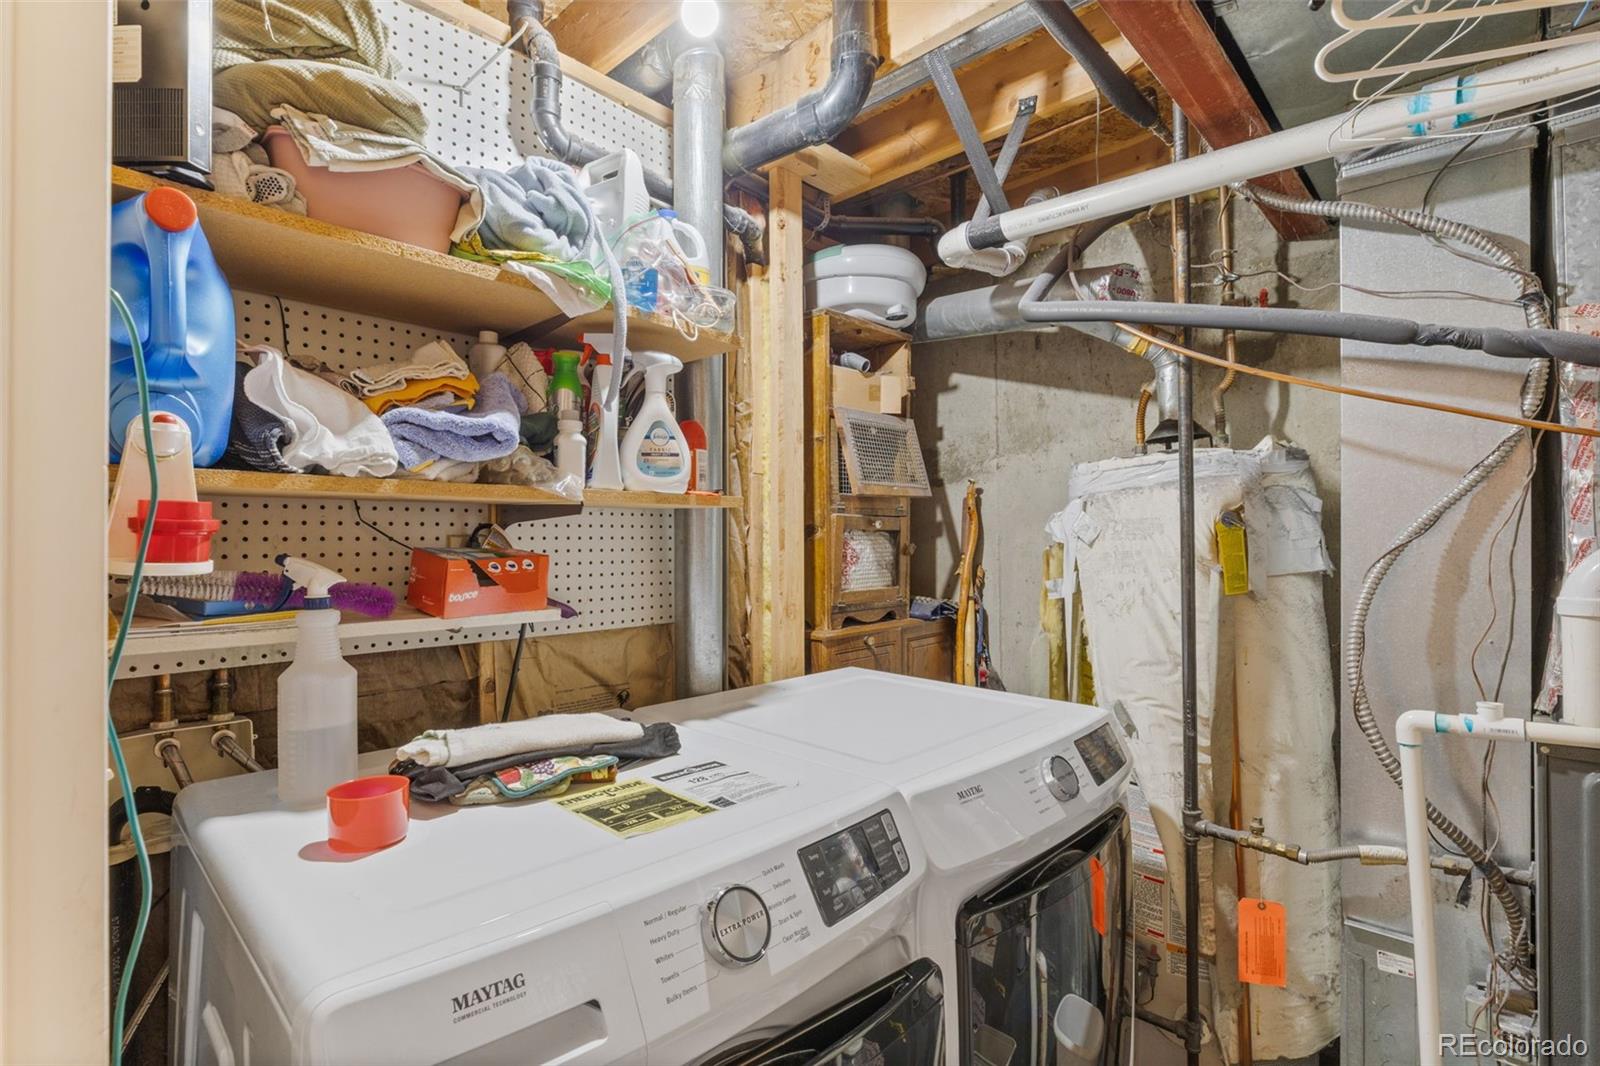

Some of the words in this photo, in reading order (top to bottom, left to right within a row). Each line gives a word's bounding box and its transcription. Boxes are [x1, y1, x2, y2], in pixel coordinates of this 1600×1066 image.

[448, 590, 479, 603] bounce
[955, 784, 984, 801] MAYTAG
[643, 912, 664, 927] Normal
[667, 905, 687, 917] Regular
[720, 922, 742, 938] EXTRA
[742, 909, 764, 926] POWER
[649, 934, 667, 945] Heavy
[655, 953, 674, 964] Whites
[661, 972, 680, 984] Towels
[451, 972, 527, 1014] MAYTAG
[666, 993, 682, 1005] Bulky
[682, 985, 698, 996] Items
[453, 1005, 491, 1024] COMMERCIAL
[493, 991, 527, 1009] TECHNOLOGY
